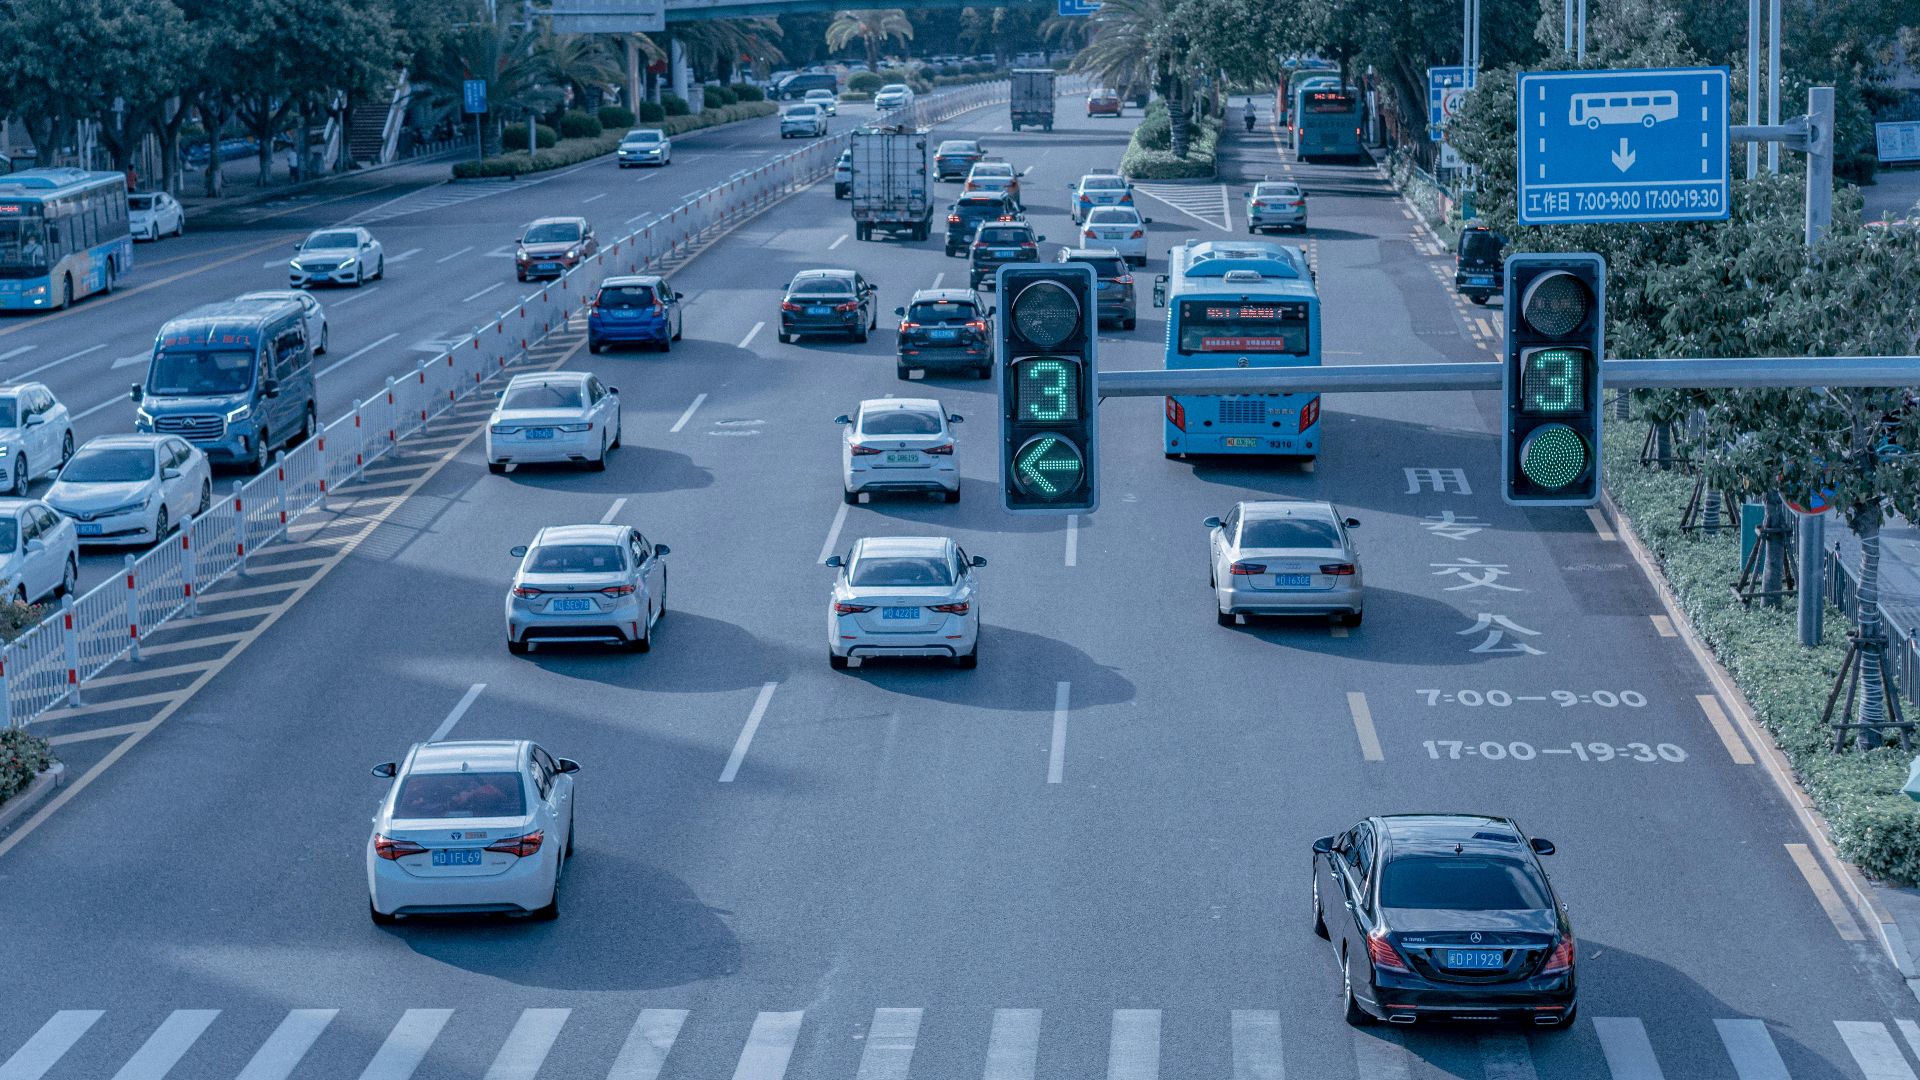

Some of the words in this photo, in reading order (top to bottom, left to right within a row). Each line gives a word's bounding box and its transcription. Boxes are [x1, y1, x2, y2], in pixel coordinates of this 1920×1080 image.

[1528, 191, 1570, 213] 工作日
[1575, 190, 1641, 211] 7:00-9:00
[1645, 188, 1719, 209] 17:00-19:30
[1031, 361, 1066, 419] 3
[1537, 352, 1571, 410] 3
